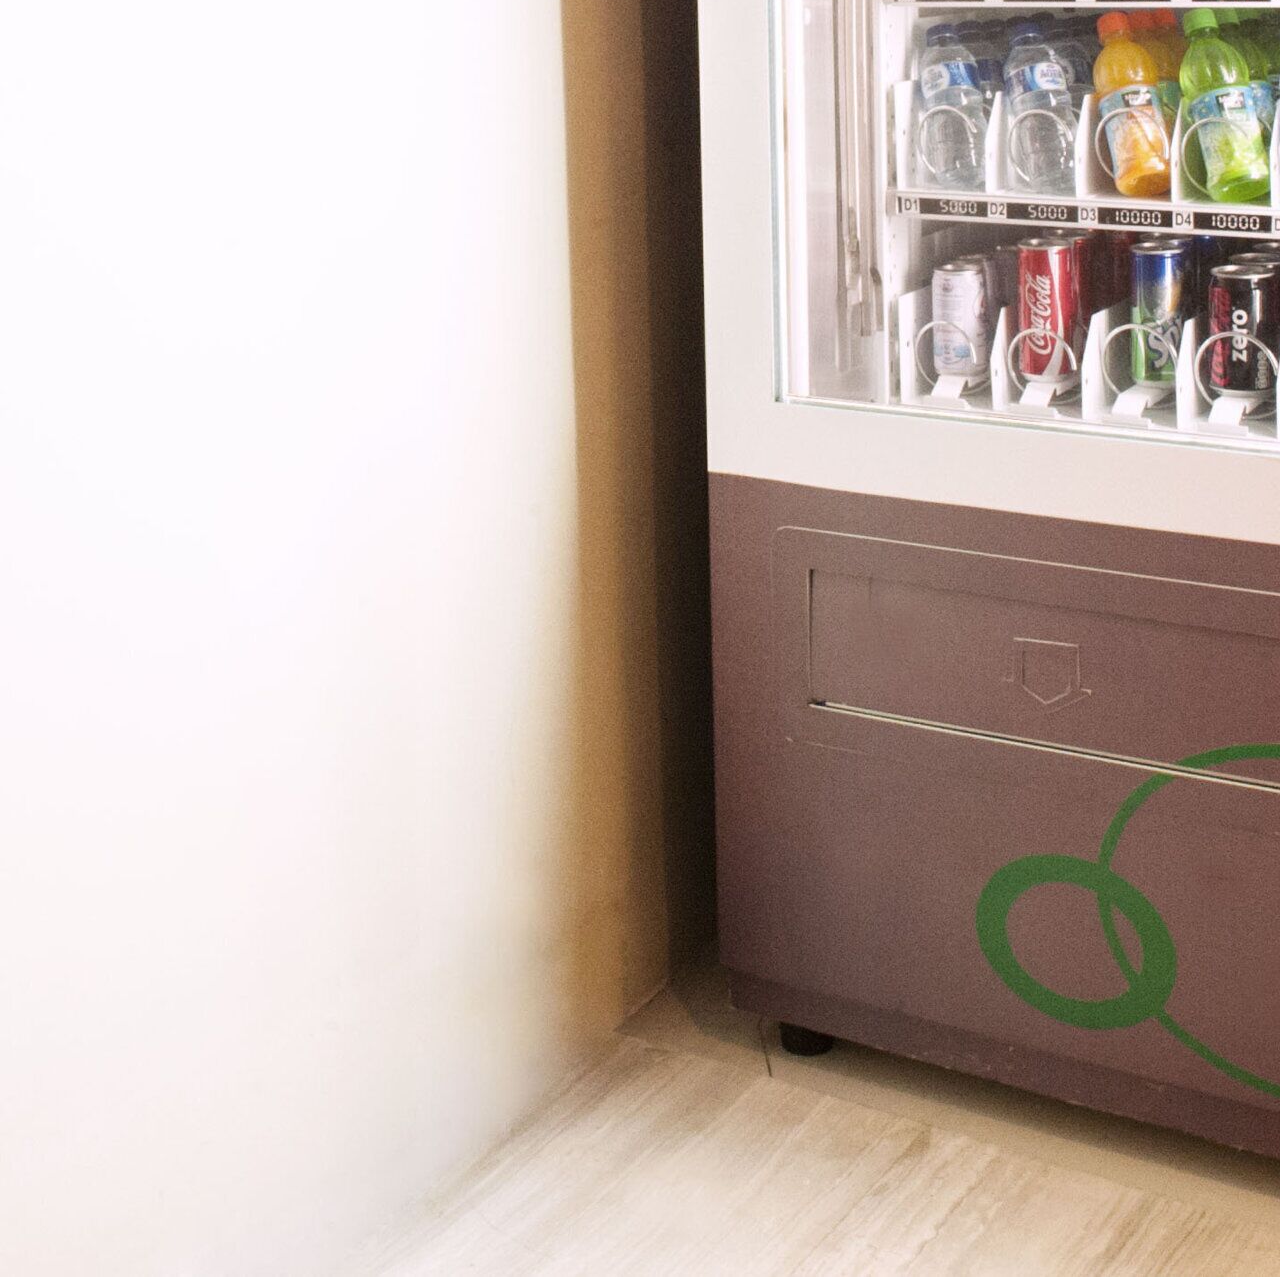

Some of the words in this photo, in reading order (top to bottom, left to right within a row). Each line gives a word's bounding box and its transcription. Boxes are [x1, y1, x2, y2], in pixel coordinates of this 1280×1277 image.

[904, 198, 918, 211] D1
[939, 199, 977, 213] 5000
[989, 202, 1005, 216] D2
[1027, 205, 1068, 219] 5000
[1080, 207, 1097, 221] D3
[1115, 210, 1162, 225] 10000
[1175, 212, 1192, 227] D4
[1211, 215, 1260, 230] 10000
[1231, 308, 1249, 363] zero
